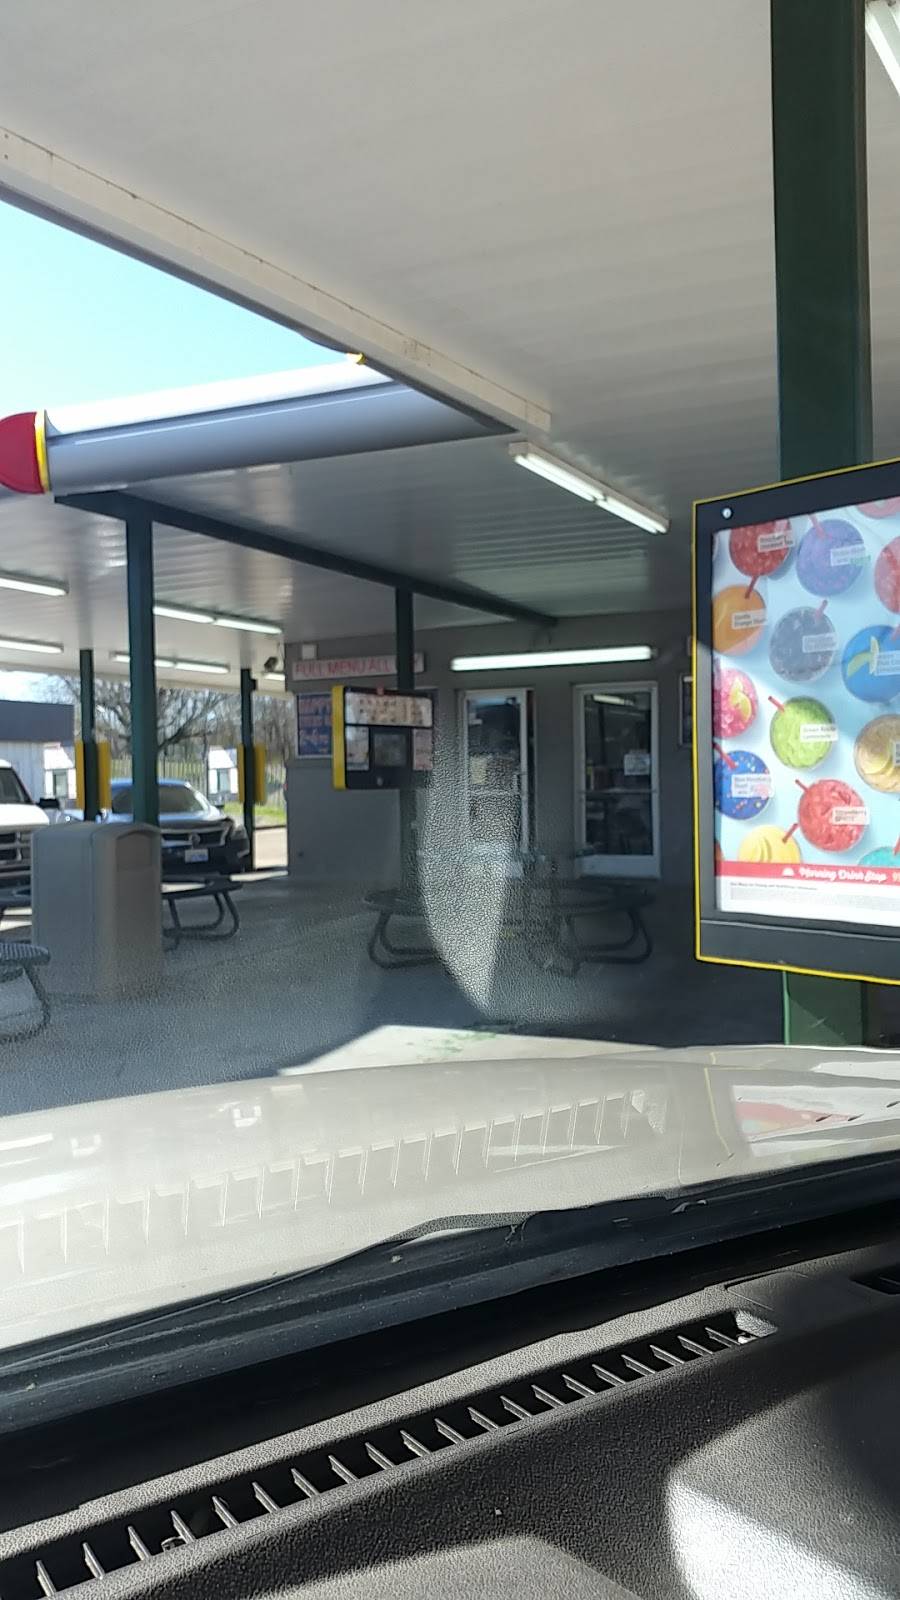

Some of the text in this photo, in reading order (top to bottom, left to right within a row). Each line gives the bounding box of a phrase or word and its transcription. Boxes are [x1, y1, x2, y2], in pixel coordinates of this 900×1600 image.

[328, 659, 365, 675] MENU
[799, 867, 837, 881] Morning
[838, 869, 864, 880] Drink
[864, 870, 887, 883] Stop
